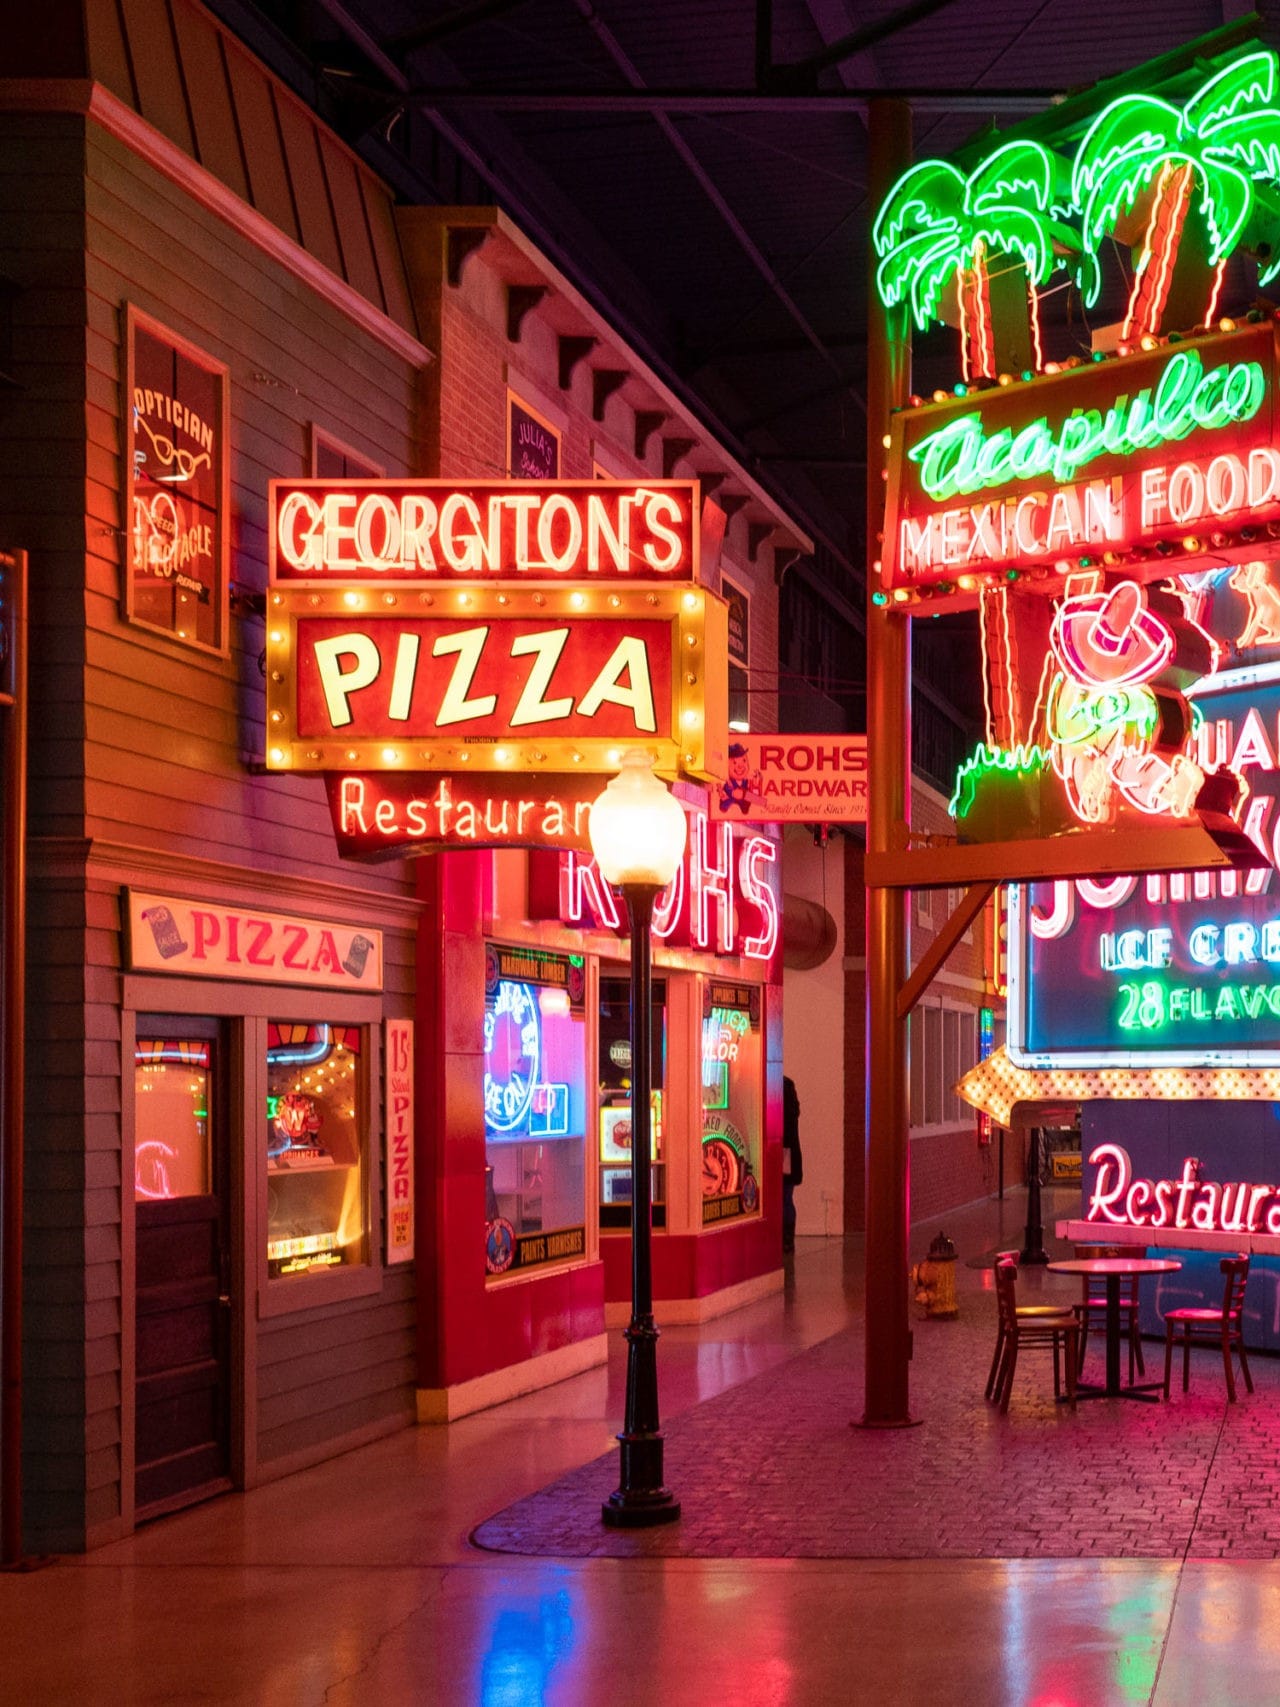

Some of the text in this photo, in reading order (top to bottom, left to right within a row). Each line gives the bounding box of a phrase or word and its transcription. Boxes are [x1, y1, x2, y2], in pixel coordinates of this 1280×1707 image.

[134, 387, 213, 453] OPTICIAN
[908, 349, 1266, 502] Acapulco
[278, 489, 683, 573] GEORGITON'S
[901, 477, 1124, 573] MEXICAN
[176, 573, 203, 594] REPAIR
[313, 625, 658, 733] PIZZA
[749, 779, 867, 798] HARDWAR
[760, 745, 867, 771] ROHS
[340, 777, 592, 838] Restauran
[190, 909, 346, 976] PIZZA
[1100, 928, 1174, 970] ICE
[1118, 981, 1164, 1030] 28
[393, 1097, 410, 1199] PIZZA
